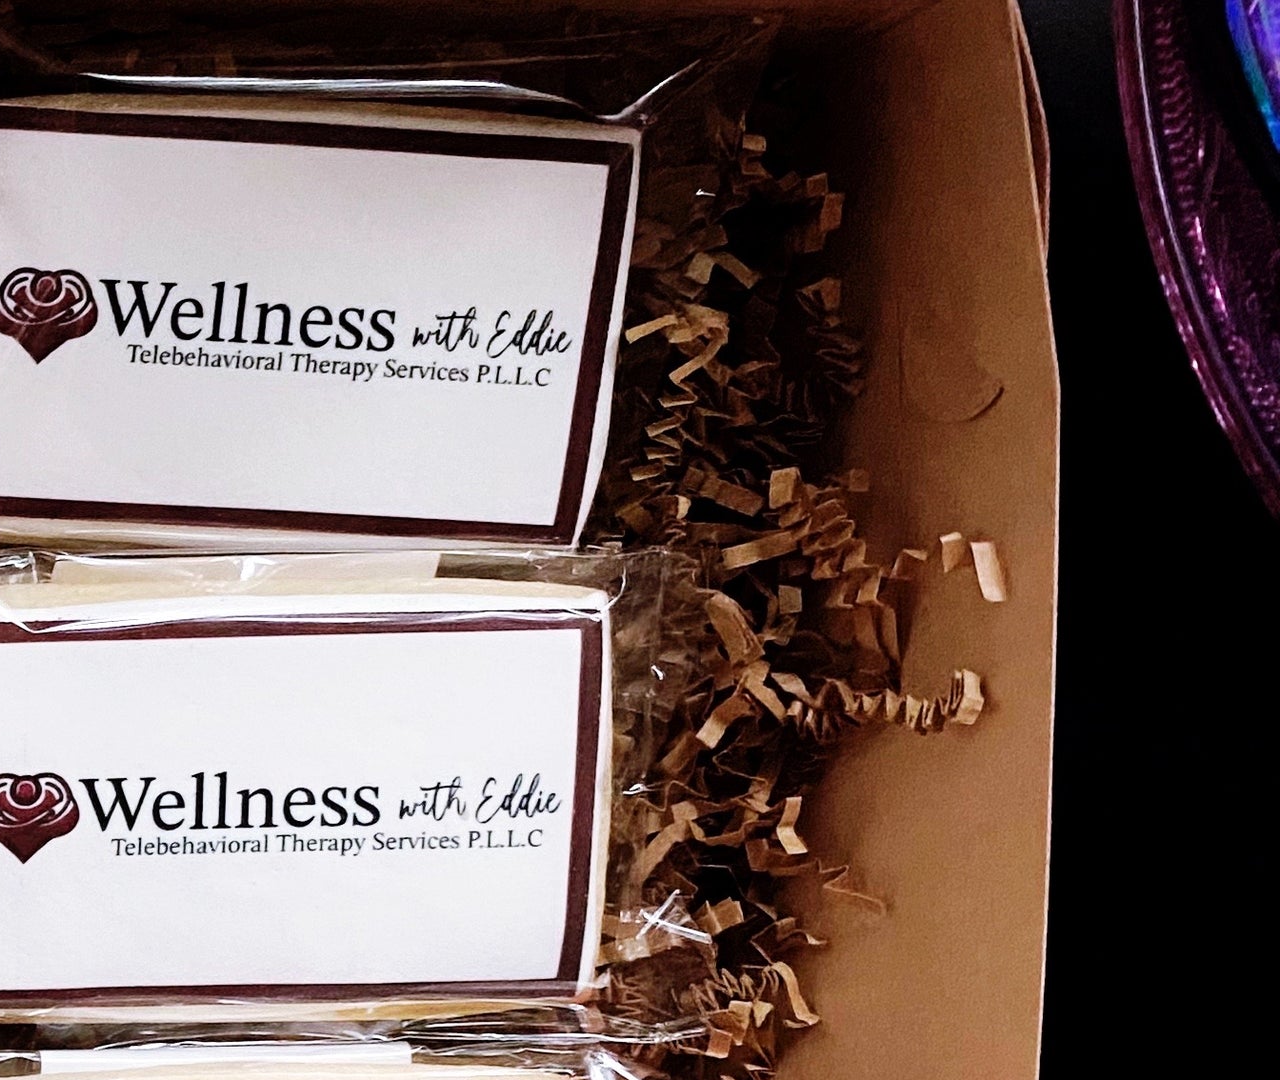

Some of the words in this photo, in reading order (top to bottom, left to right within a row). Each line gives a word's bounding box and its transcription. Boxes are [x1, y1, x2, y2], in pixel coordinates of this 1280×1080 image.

[99, 279, 396, 352] Wellness
[412, 306, 479, 352] with
[486, 309, 572, 358] Eddie
[127, 344, 283, 371] Telebehavioral
[290, 353, 378, 382] Therapy
[383, 359, 469, 382] Services
[477, 365, 551, 387] P.L.L.C
[78, 771, 380, 832] Wellness
[399, 776, 466, 821] with
[475, 773, 561, 824] Eddie
[111, 834, 268, 856] Telebehavioral
[276, 834, 366, 856] Therapy
[373, 832, 459, 850] Services
[469, 829, 543, 848] P.L.L.C
